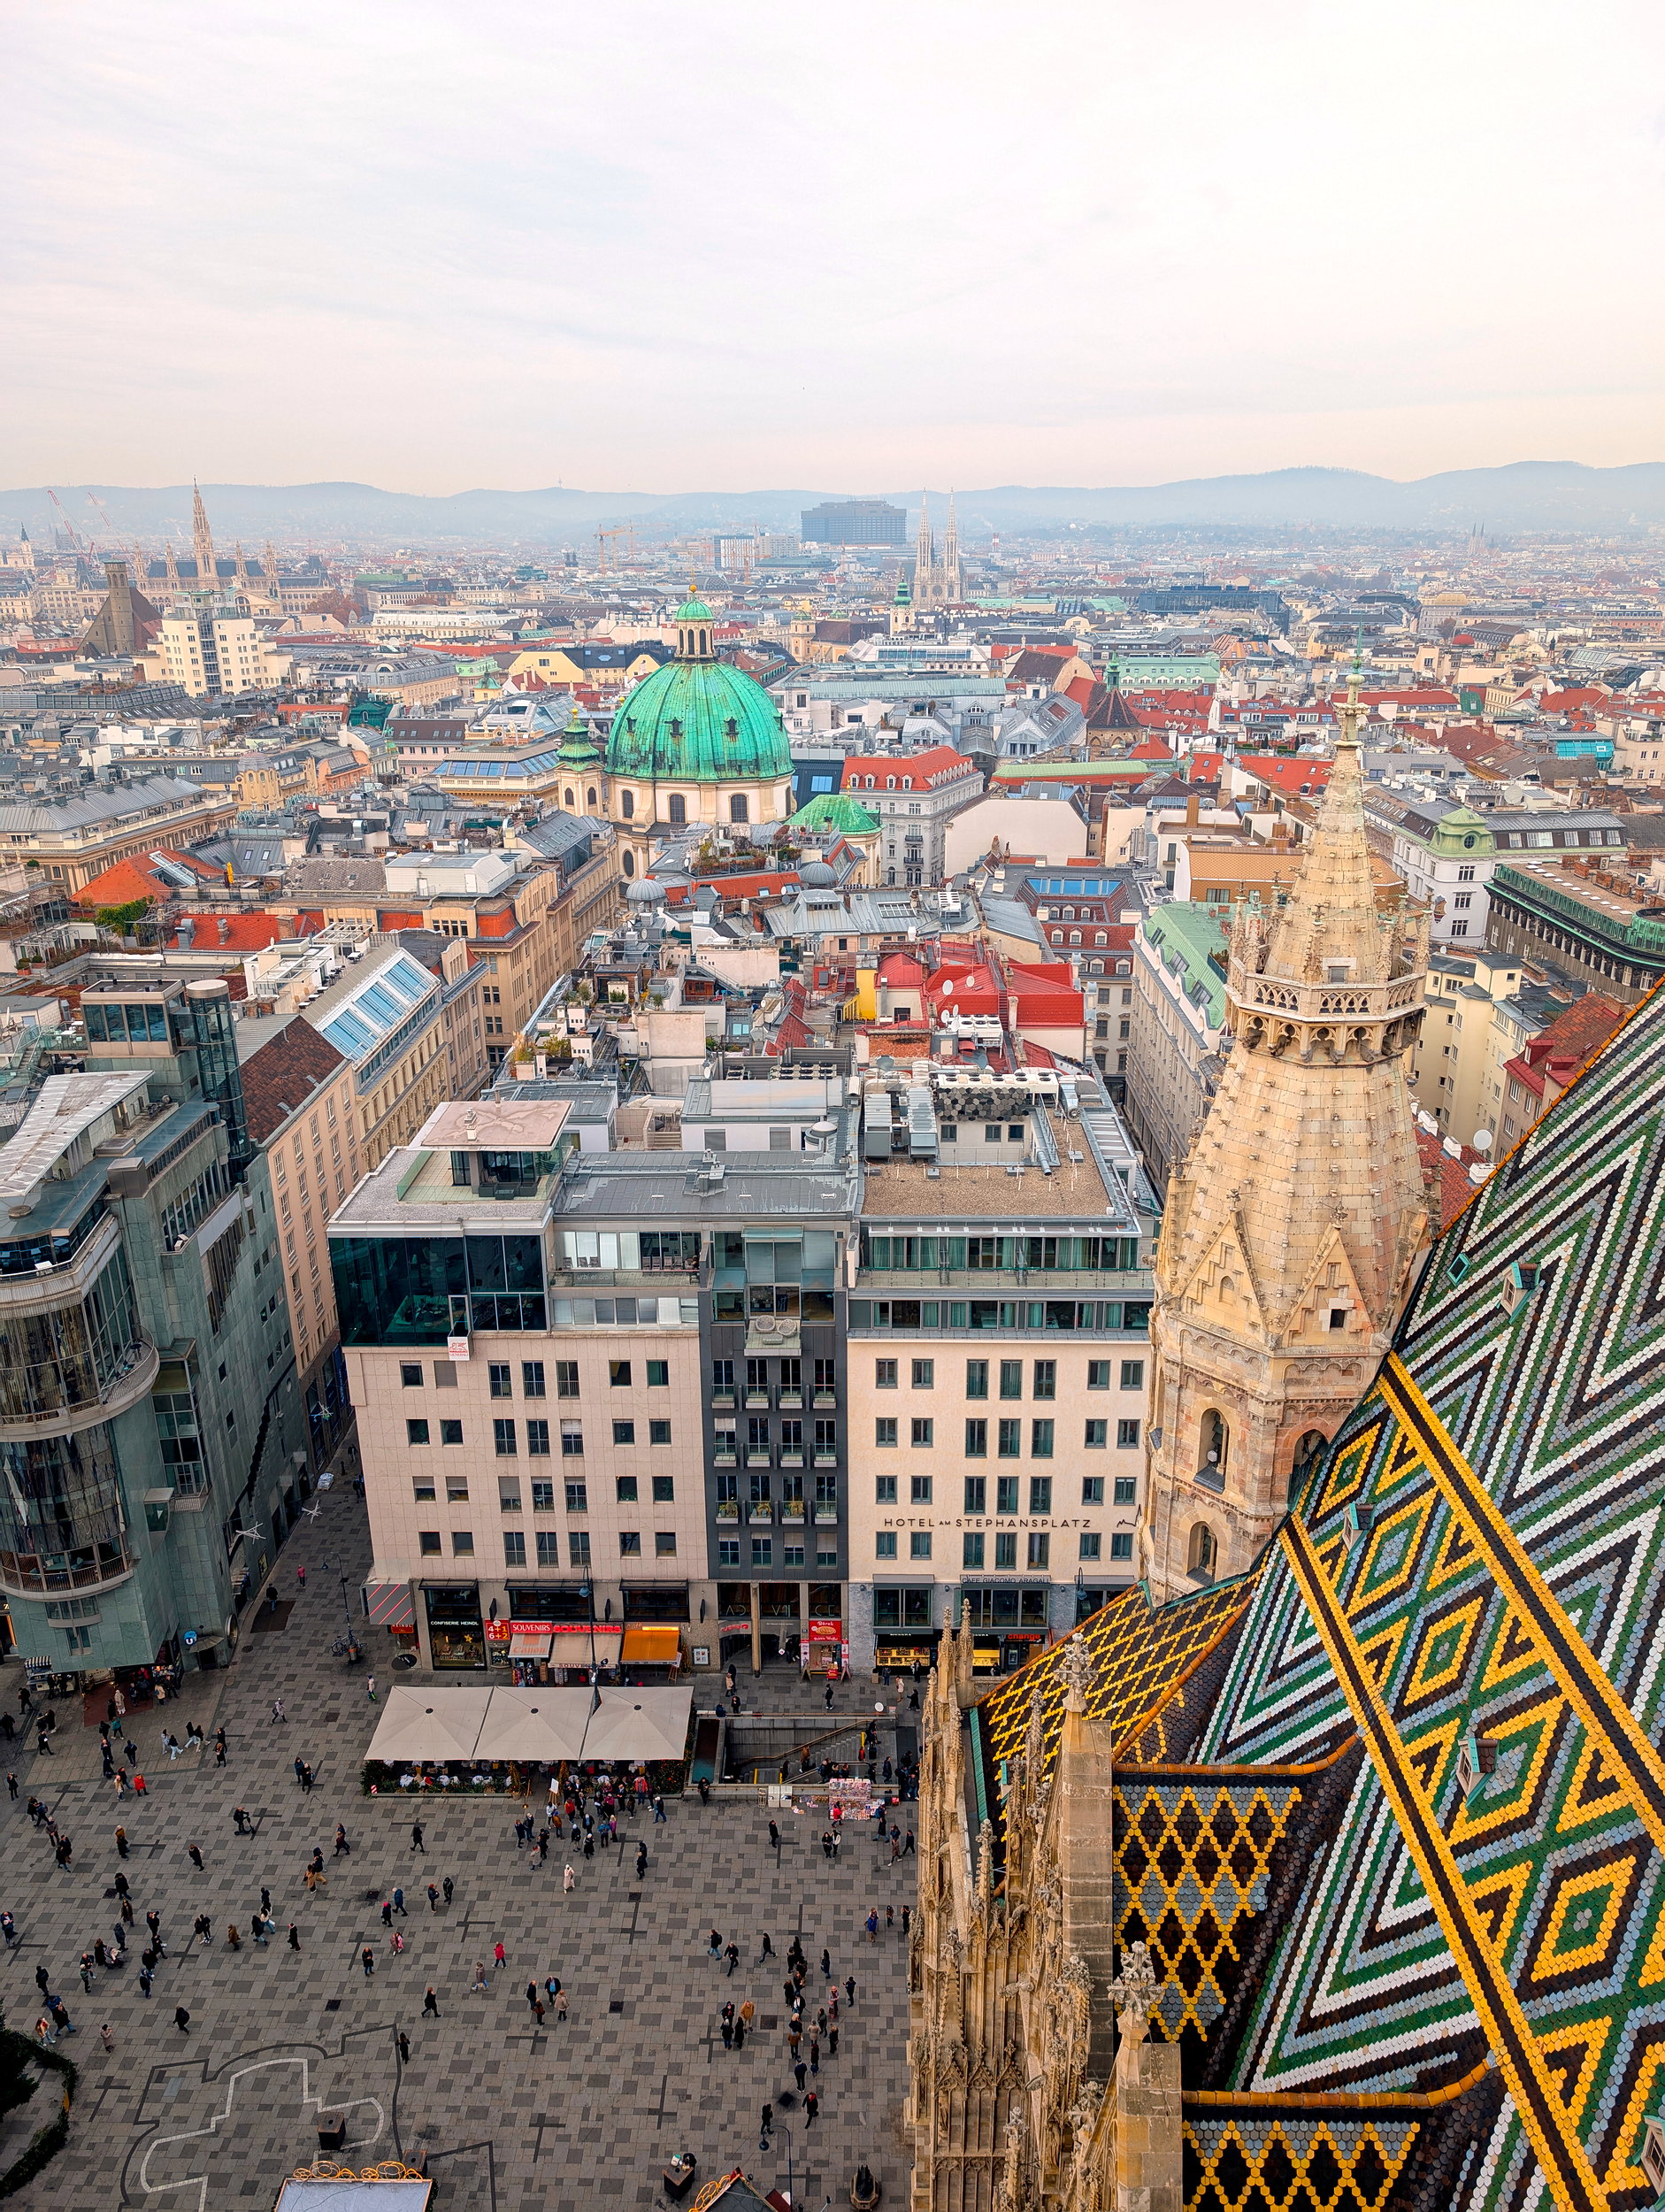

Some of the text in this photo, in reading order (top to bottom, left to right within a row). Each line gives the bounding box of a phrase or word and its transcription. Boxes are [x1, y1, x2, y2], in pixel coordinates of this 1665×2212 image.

[885, 1518, 934, 1527] HOTEL
[955, 1518, 1091, 1528] STEPHANSPLATZ
[553, 1624, 621, 1633] SOUVENIRS
